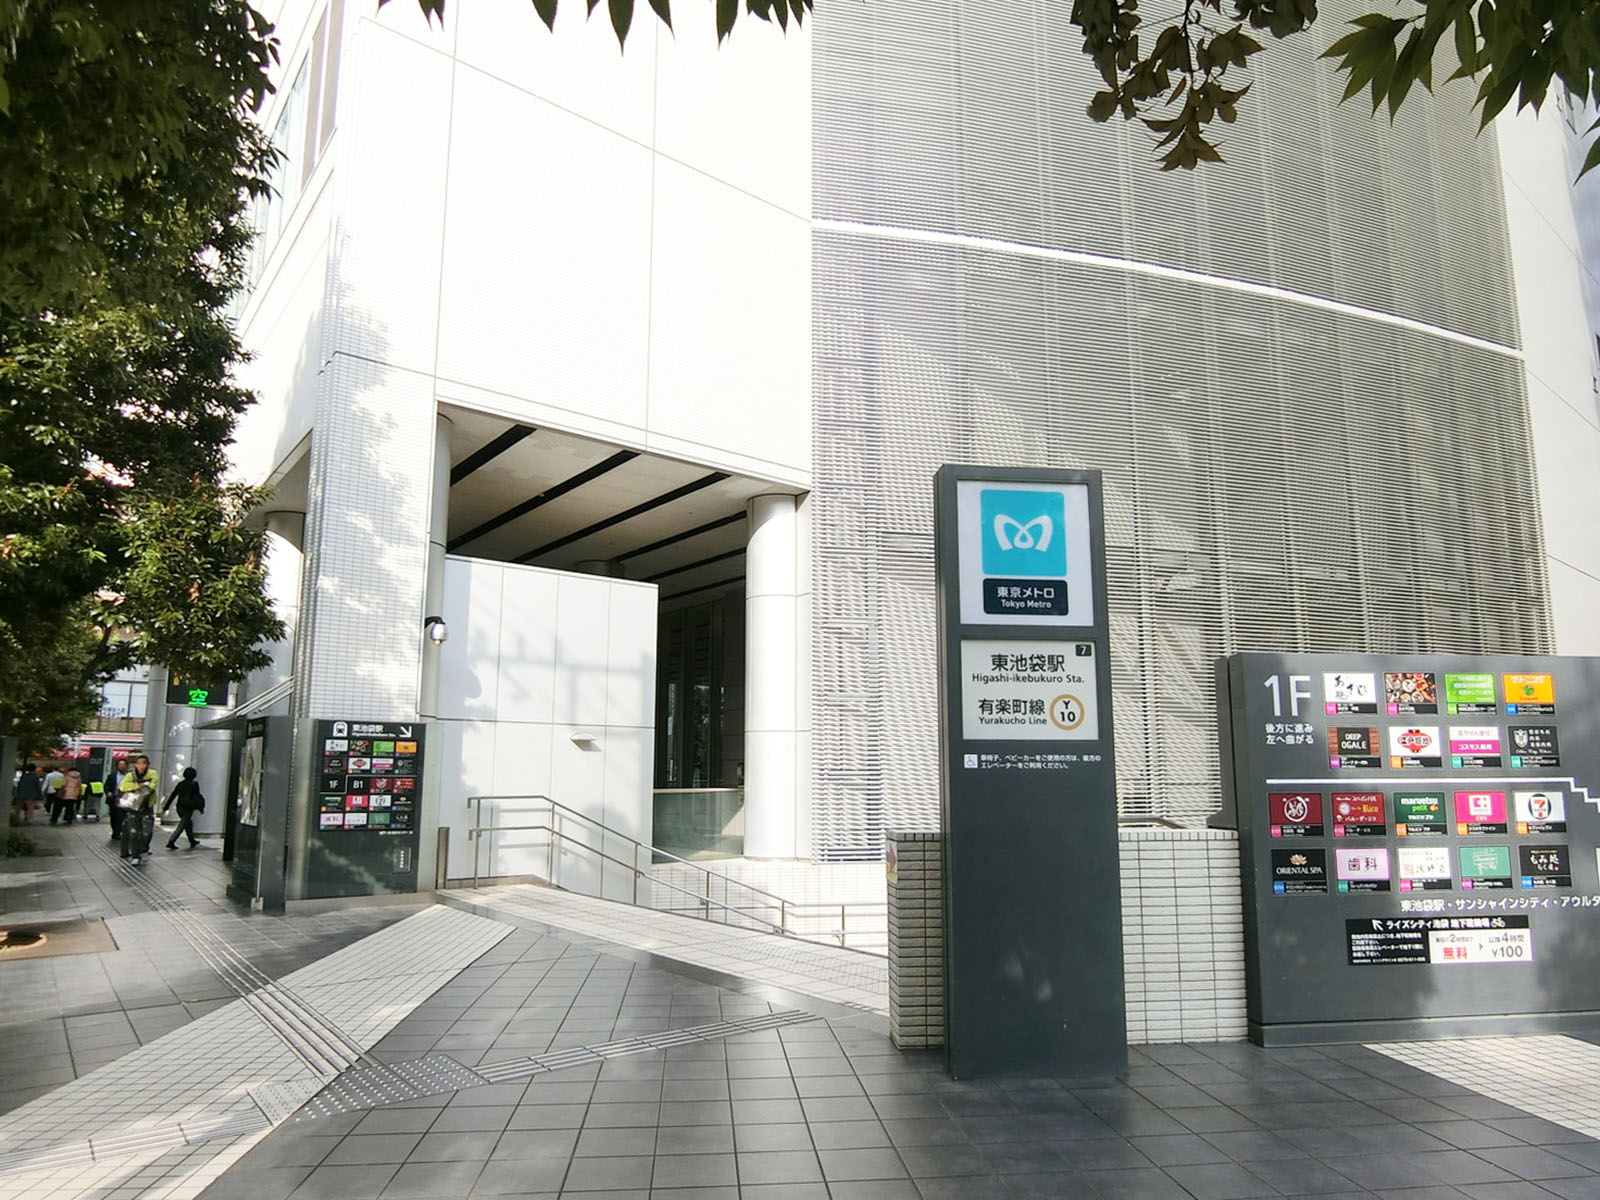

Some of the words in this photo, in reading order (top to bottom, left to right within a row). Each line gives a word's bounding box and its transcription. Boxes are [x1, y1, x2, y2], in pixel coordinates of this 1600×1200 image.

[996, 586, 1055, 599] 東京メトロ
[1001, 599, 1026, 609] Tokyo
[1027, 600, 1052, 609] Metro
[1079, 645, 1087, 655] 7
[990, 653, 1066, 673] 東池袋駅
[971, 673, 1063, 685] Higashi-ikebukuro
[1066, 674, 1085, 683] Sta.
[188, 688, 208, 706] 空
[1263, 674, 1312, 717] 1F
[978, 698, 1046, 716] 有楽町線
[1062, 700, 1071, 710] Y
[978, 716, 1026, 725] Yurakucho
[1029, 716, 1048, 725] Line
[1060, 711, 1076, 723] 10
[1265, 723, 1313, 734] 後方に進み
[1266, 734, 1314, 745] 左へ曲がる
[1345, 732, 1362, 740] DEEP
[1341, 741, 1368, 750] OGALE
[329, 780, 340, 789] 1F
[353, 780, 363, 789] B1
[1348, 857, 1378, 871] 歯科
[1276, 867, 1309, 875] ORIENTAL
[1309, 867, 1323, 875] SPA
[1443, 946, 1467, 960] 無料
